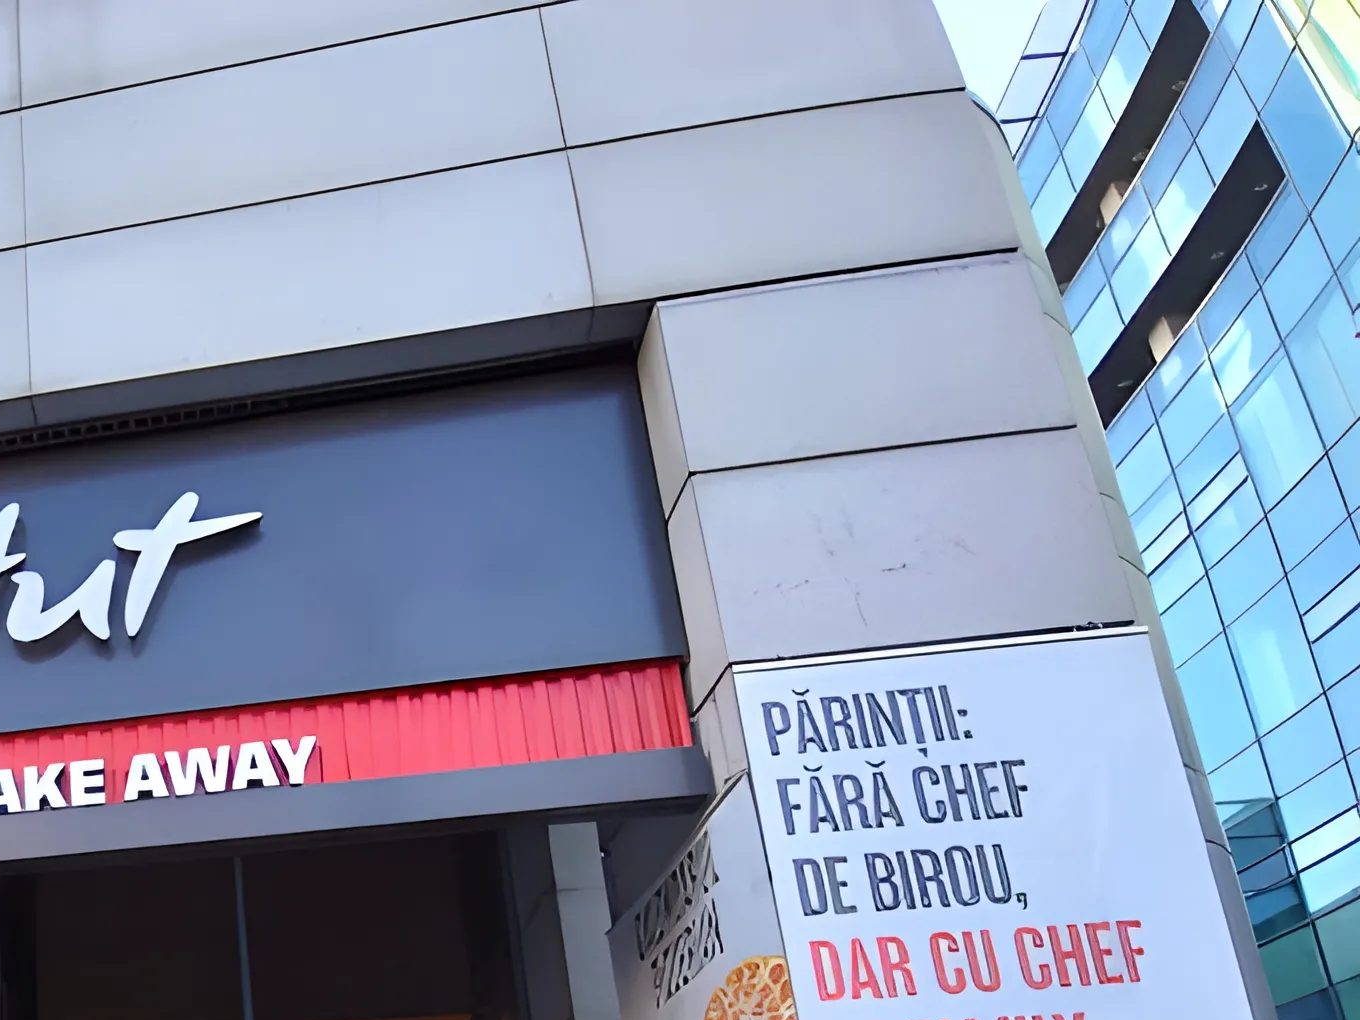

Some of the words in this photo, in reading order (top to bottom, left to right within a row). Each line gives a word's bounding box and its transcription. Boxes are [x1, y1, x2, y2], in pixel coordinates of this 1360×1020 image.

[123, 735, 317, 802] AWAY
[776, 760, 906, 836] FĂRĂ
[912, 759, 1029, 825] CHEF
[792, 855, 858, 917] DE
[864, 844, 1029, 912] BIROU,
[809, 935, 917, 1002] DAR
[930, 929, 1002, 994] CU
[1013, 920, 1145, 990] CHEF
